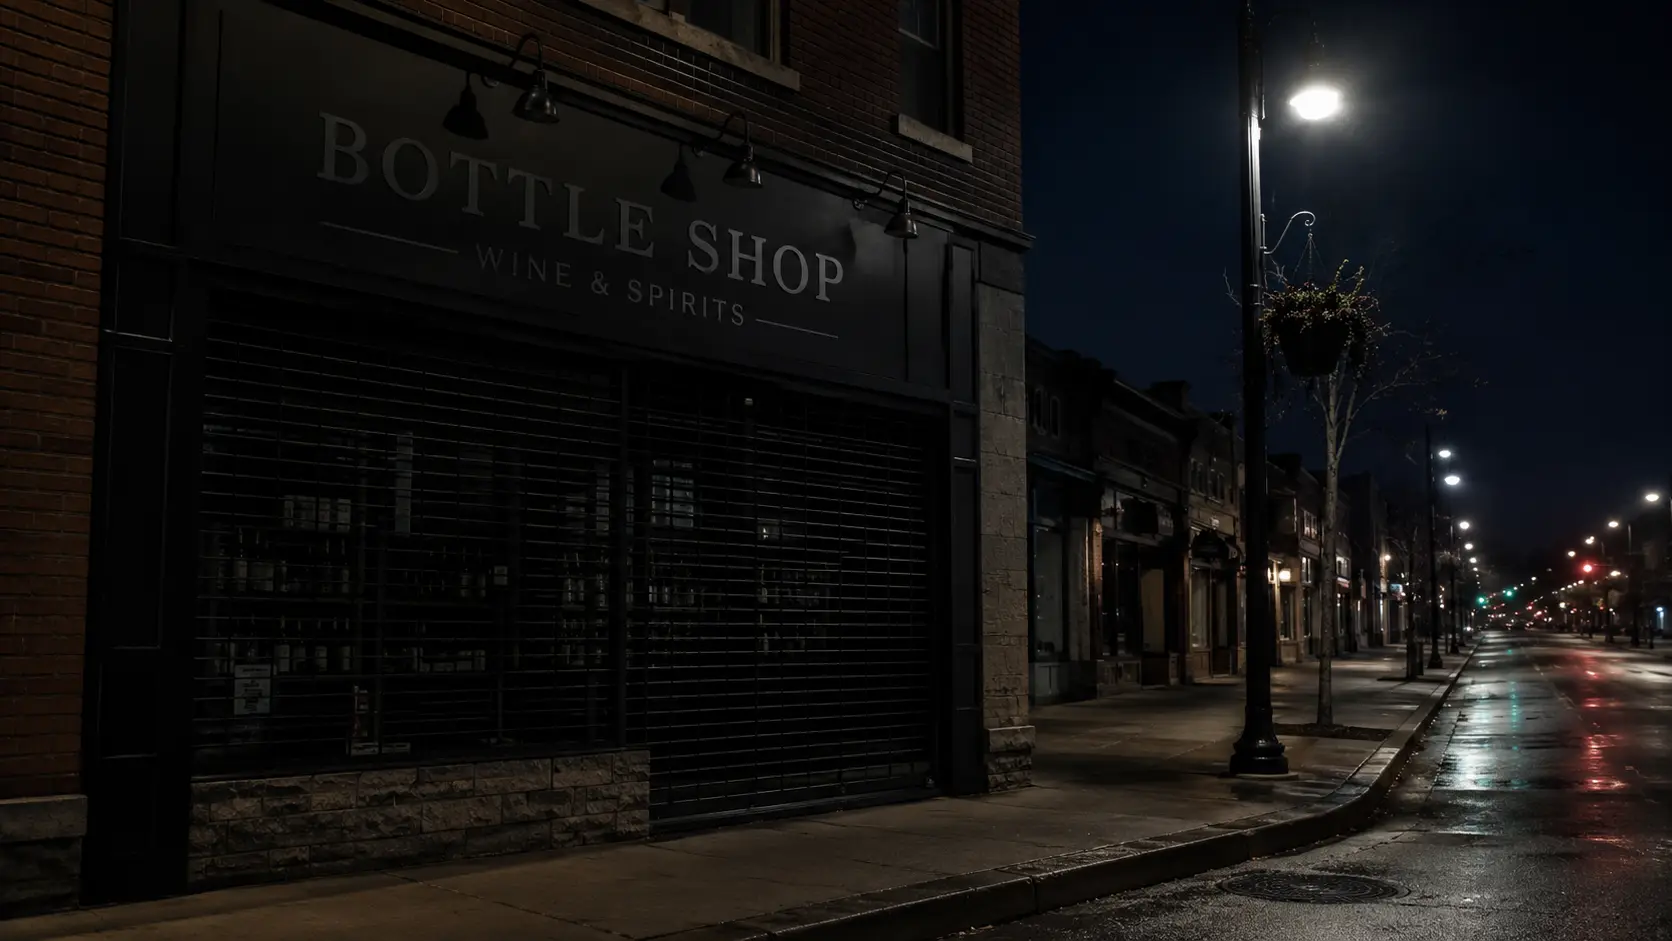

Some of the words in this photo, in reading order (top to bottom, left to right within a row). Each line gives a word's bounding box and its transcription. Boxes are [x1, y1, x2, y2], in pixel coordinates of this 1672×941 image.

[316, 110, 654, 258] BOTTLE
[687, 219, 844, 303] SHOP
[476, 243, 572, 288] WINE
[590, 270, 610, 296] &
[627, 278, 745, 327] SPIRITS
